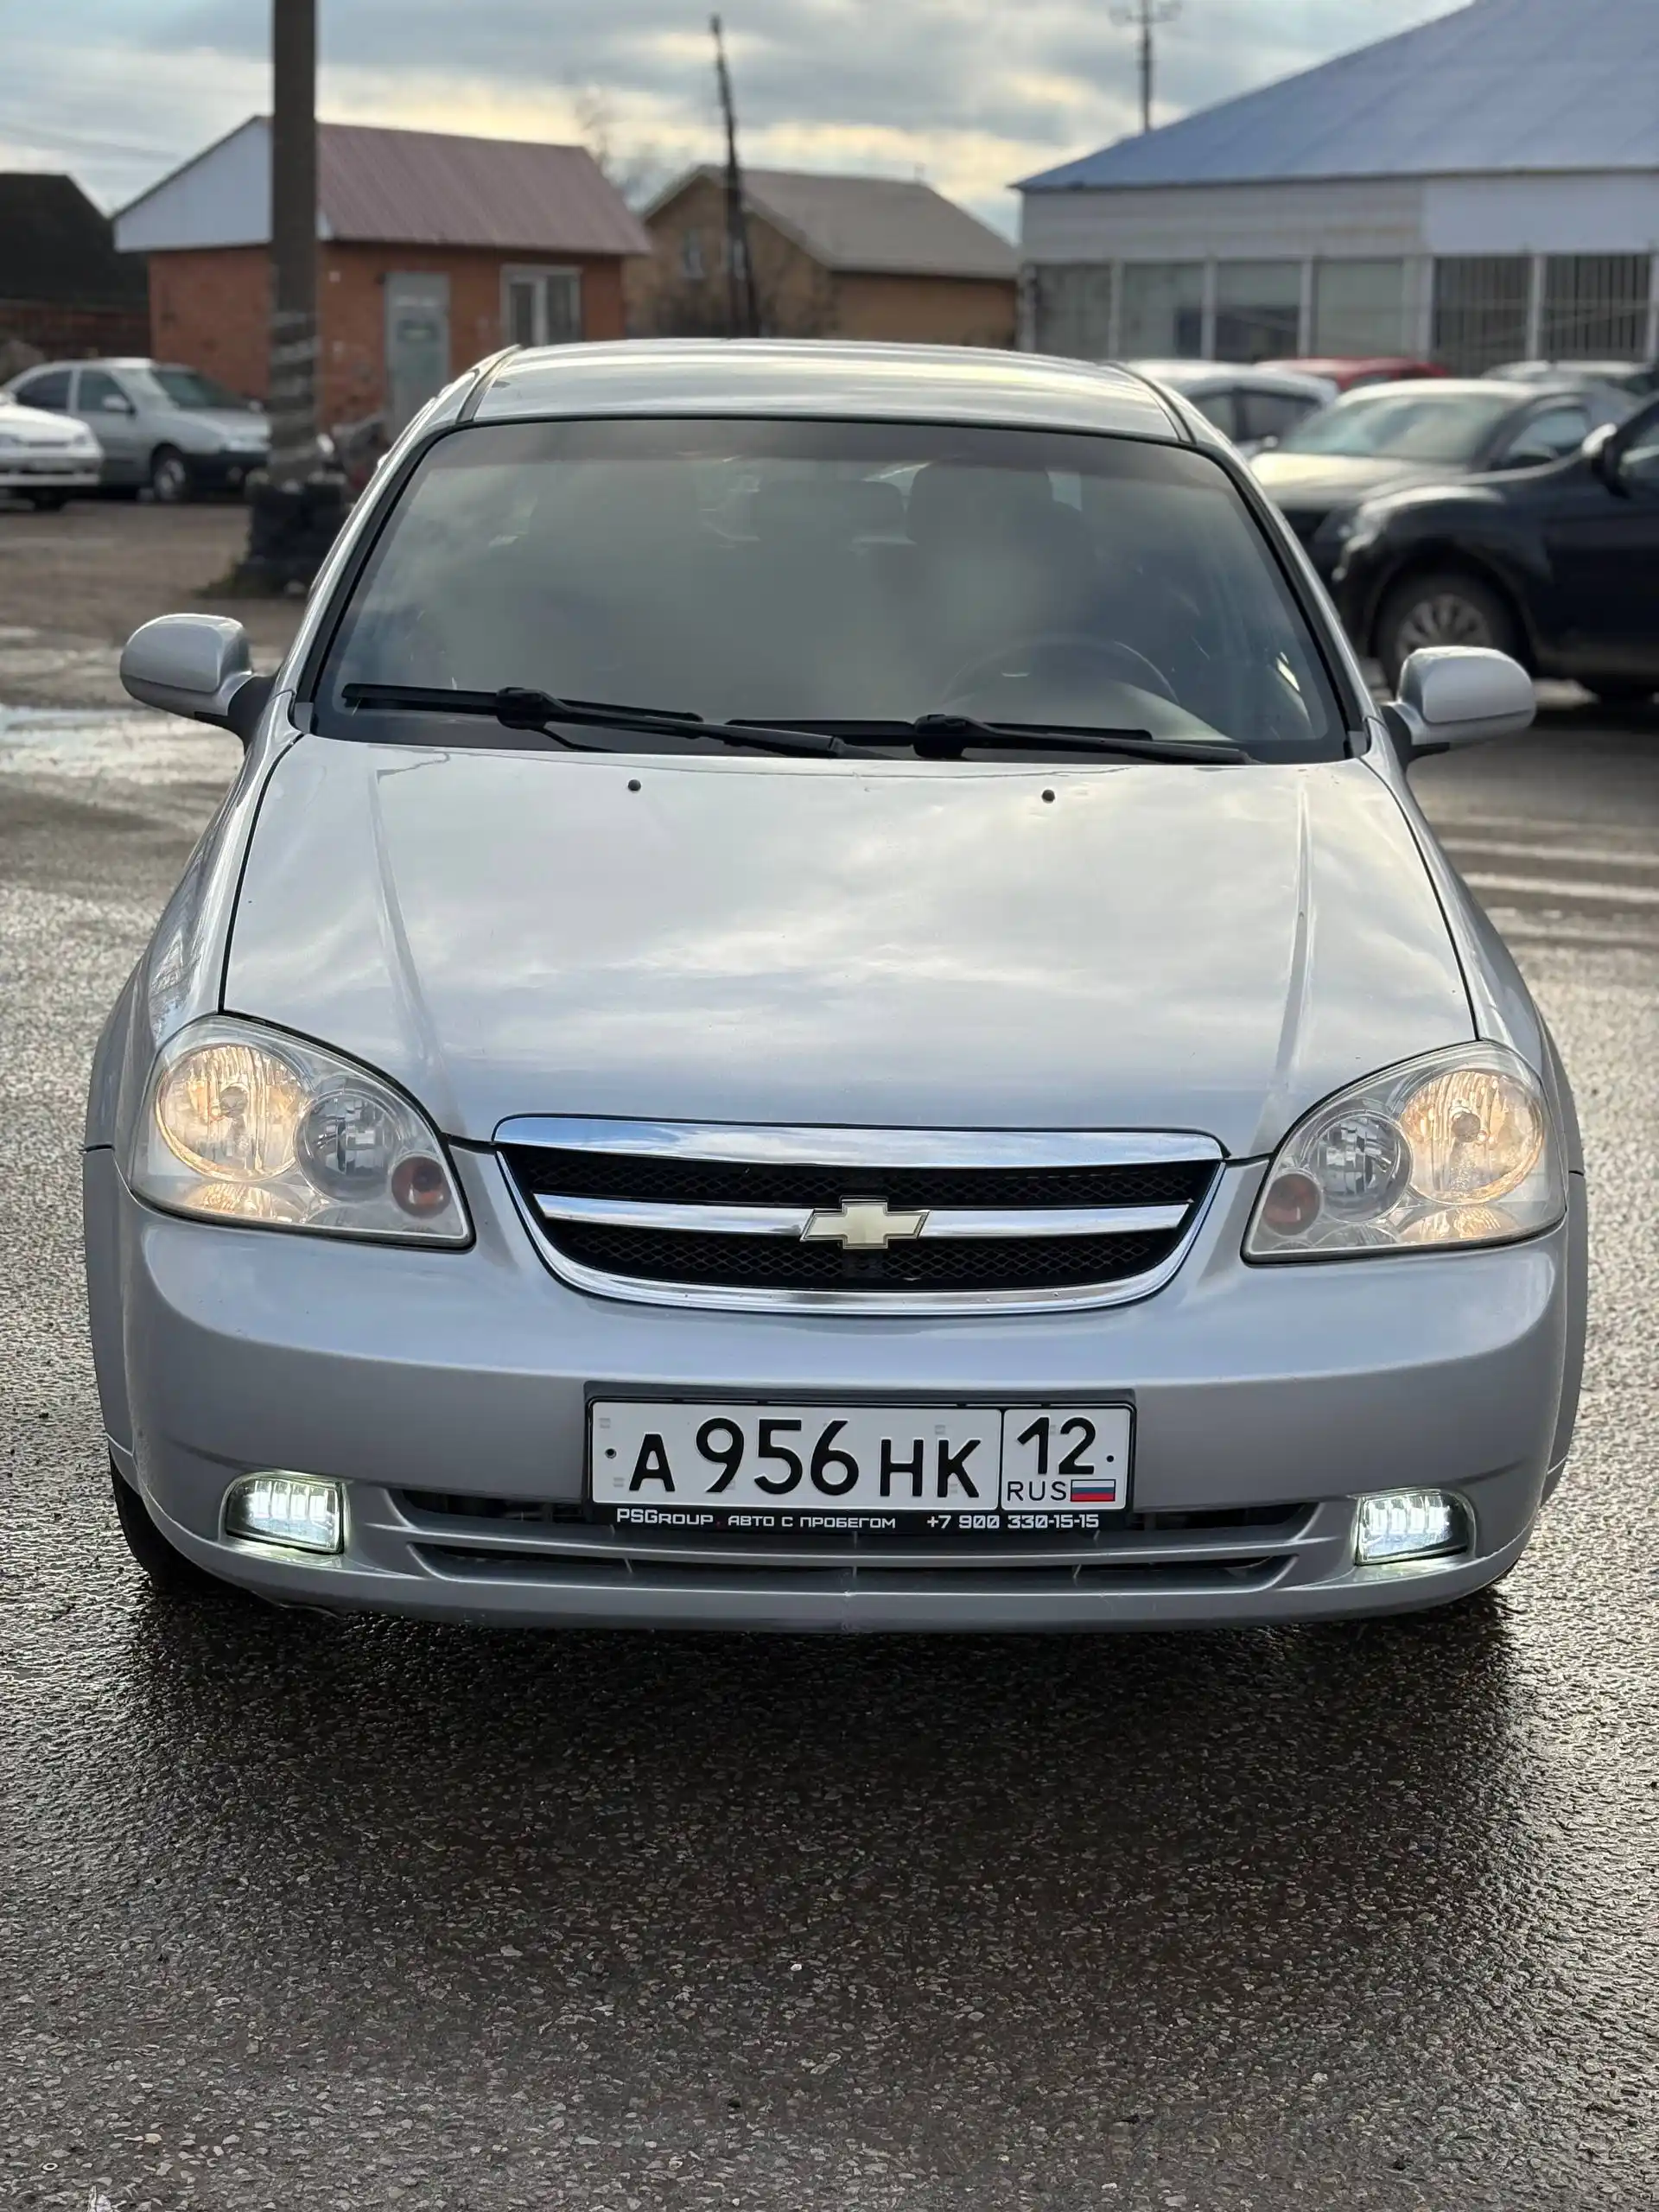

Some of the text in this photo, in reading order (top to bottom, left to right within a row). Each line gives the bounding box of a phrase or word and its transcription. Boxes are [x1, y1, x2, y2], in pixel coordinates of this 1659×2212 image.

[1016, 1416, 1096, 1475] 12
[1007, 1481, 1067, 1502] RUS
[800, 1516, 896, 1529] ПРОБЕГОМ
[927, 1515, 1099, 1529] +7 900 330-15-15
